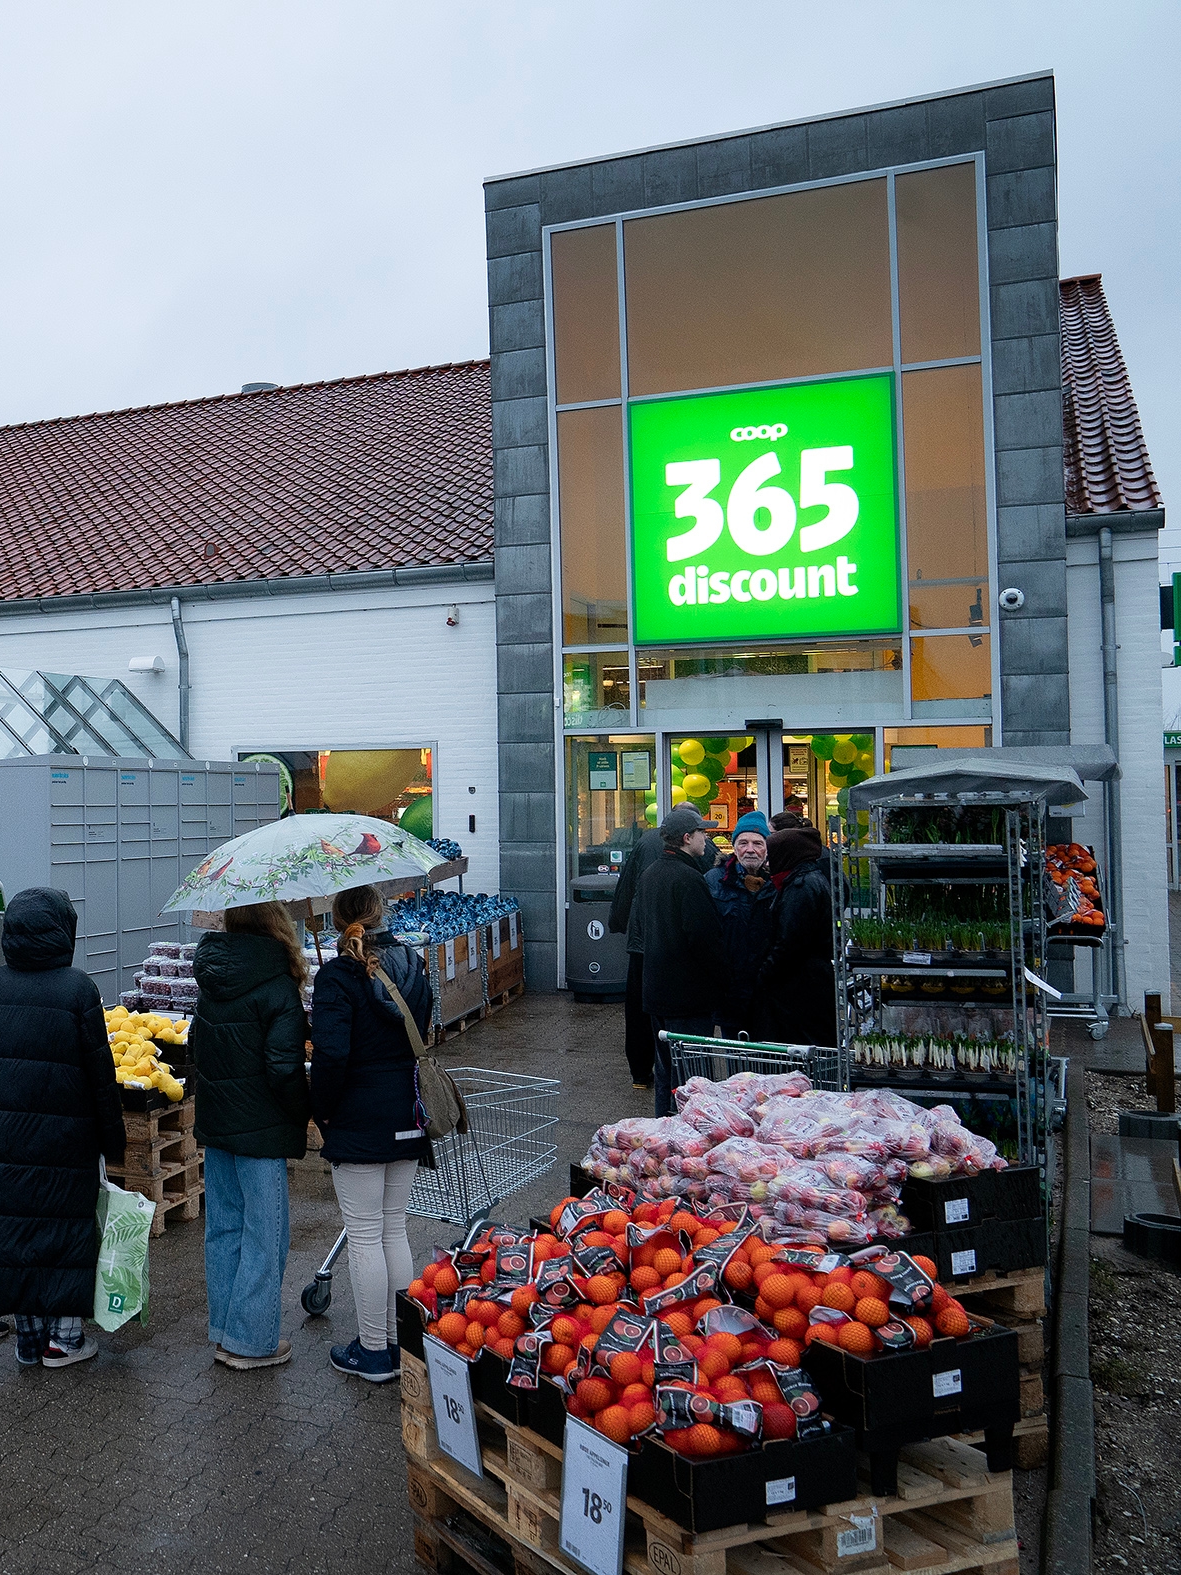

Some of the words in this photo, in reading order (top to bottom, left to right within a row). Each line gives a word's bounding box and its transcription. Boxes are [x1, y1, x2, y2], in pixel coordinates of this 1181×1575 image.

[730, 423, 788, 442] coop
[665, 445, 859, 562] 365
[668, 555, 859, 606] discount
[113, 1296, 121, 1308] D
[443, 1394, 461, 1425] 18
[582, 1487, 603, 1525] 18
[602, 1499, 612, 1514] 50
[653, 1545, 677, 1574] EPAL
